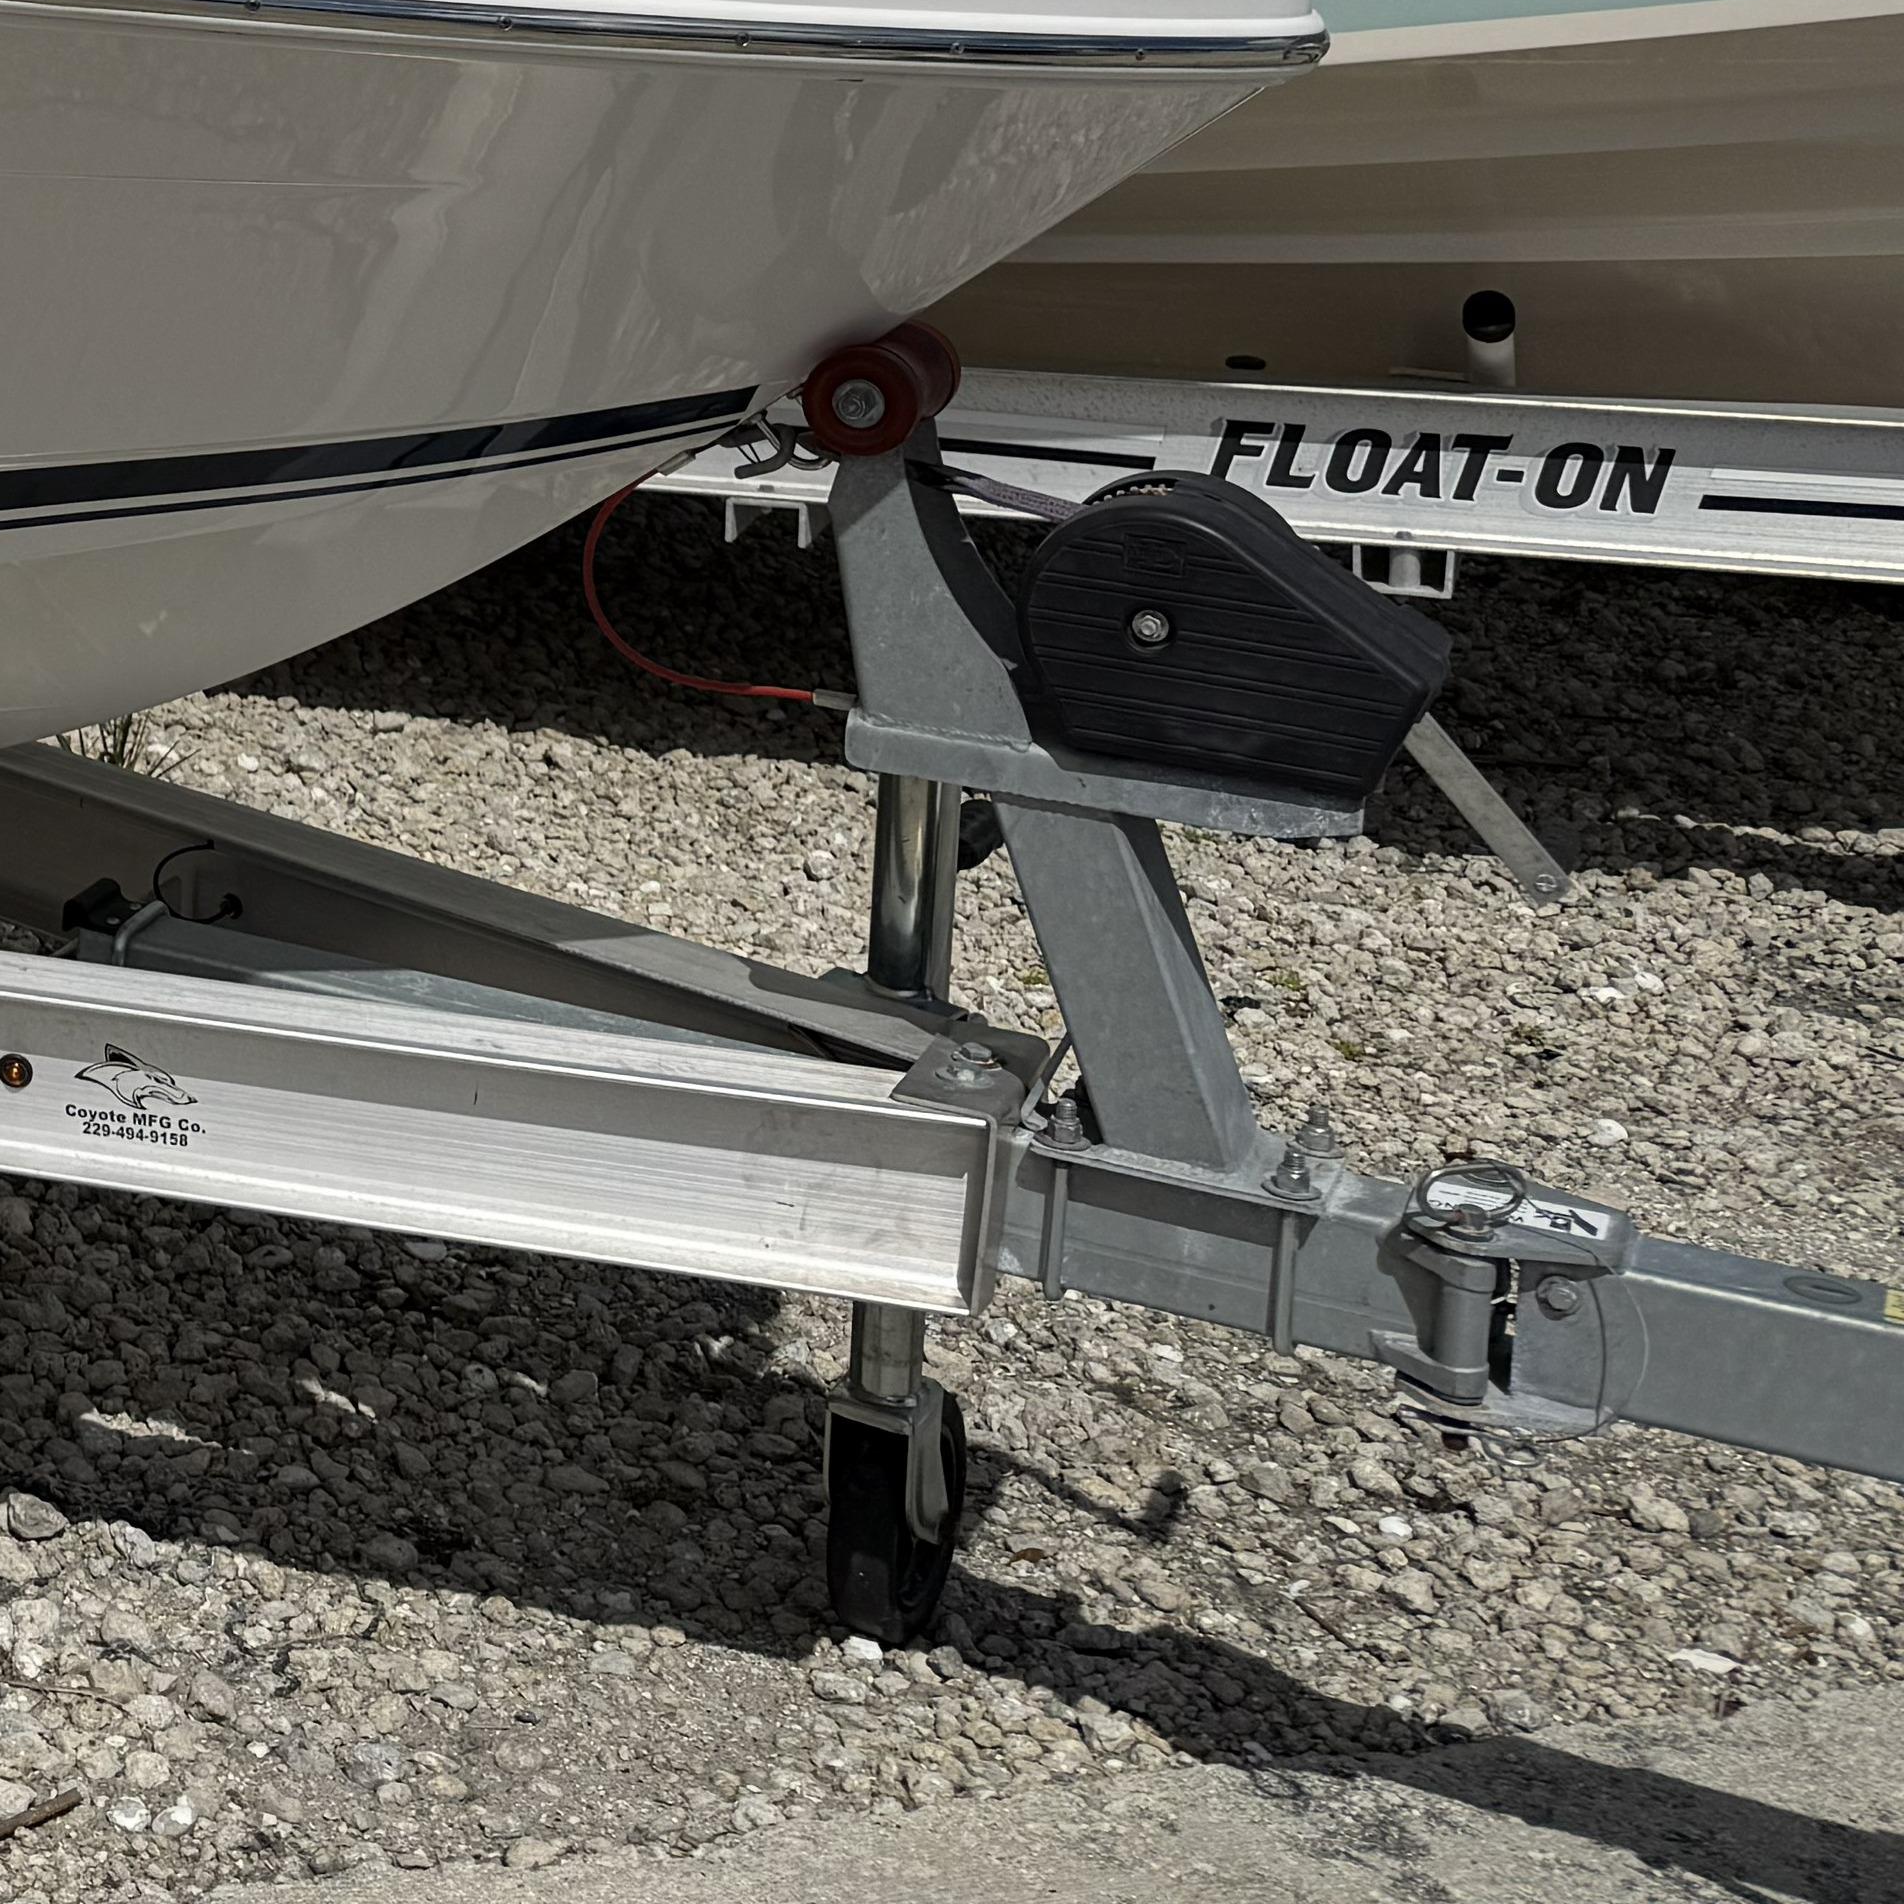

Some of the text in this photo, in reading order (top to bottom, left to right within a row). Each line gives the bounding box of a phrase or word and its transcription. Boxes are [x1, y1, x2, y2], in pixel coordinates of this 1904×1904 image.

[1210, 418, 1677, 515] FLOAT-ON
[65, 1103, 207, 1134] Coyote MFG Co.
[82, 1120, 189, 1147] 229-494-9158
